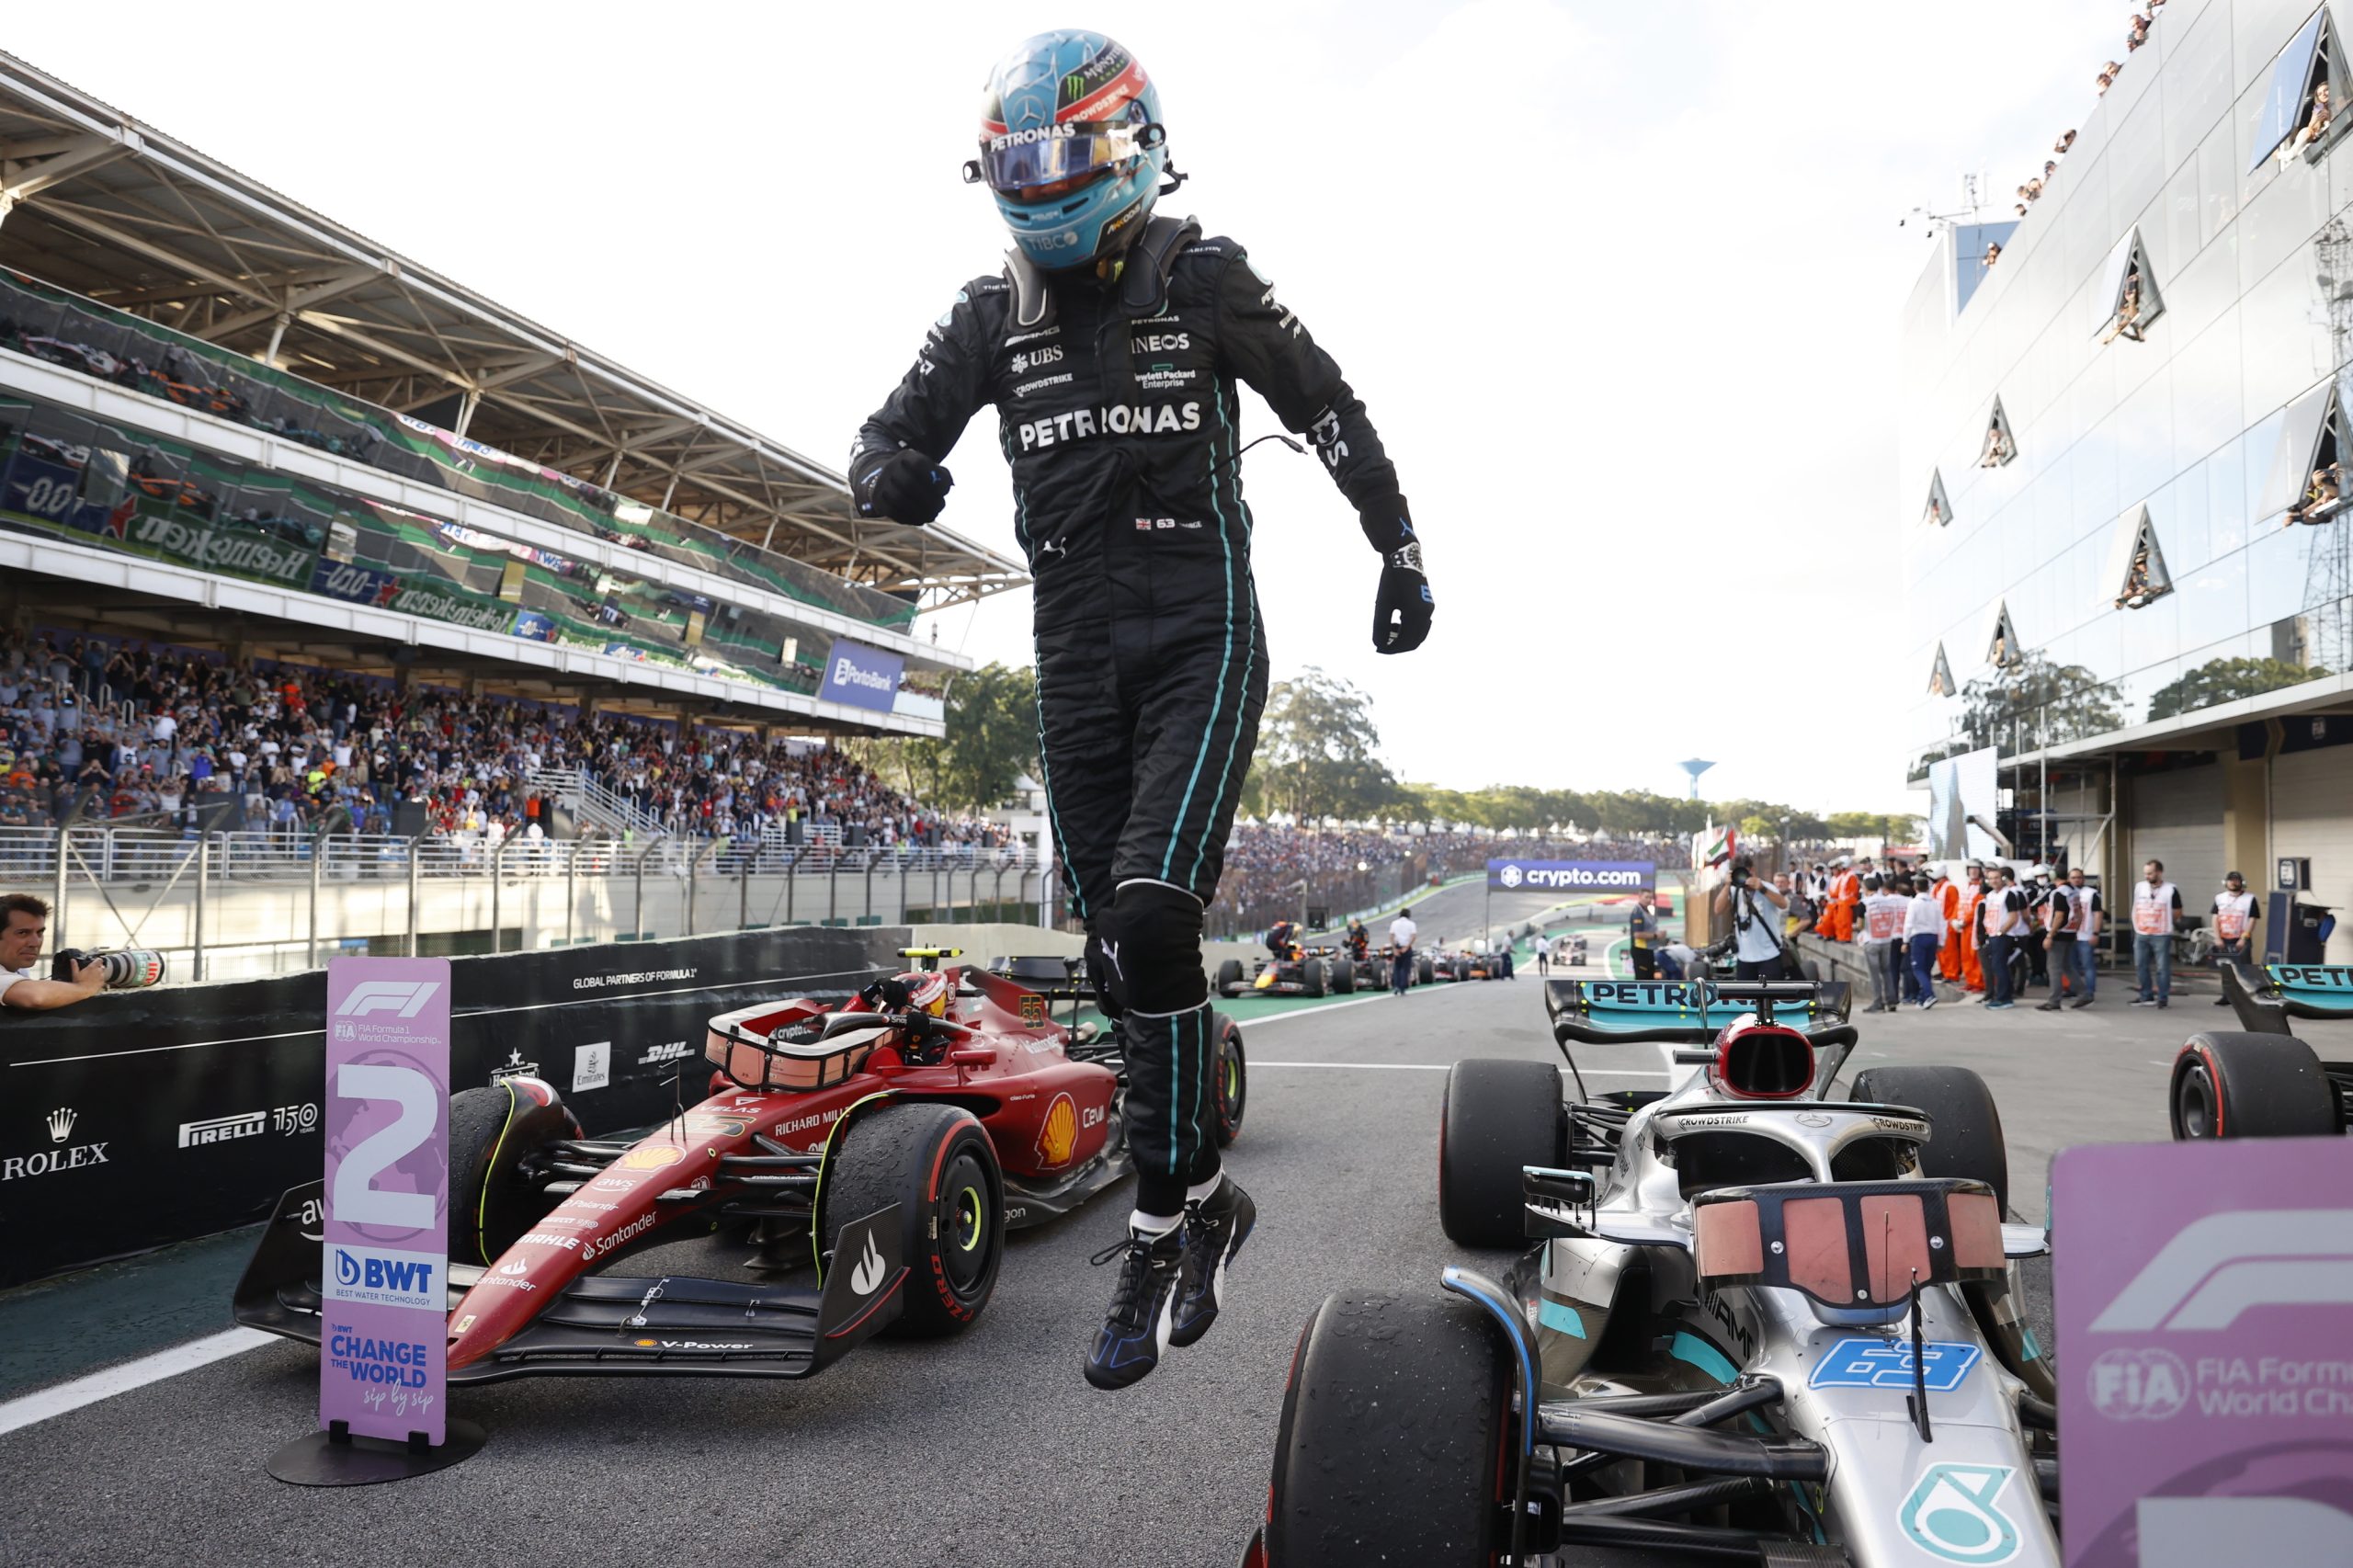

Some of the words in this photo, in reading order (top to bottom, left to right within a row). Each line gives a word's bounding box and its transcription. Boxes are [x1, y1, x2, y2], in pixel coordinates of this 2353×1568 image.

[991, 123, 1075, 153] PETRONAS
[1131, 315, 1180, 324] PETRONAS
[1131, 333, 1190, 355] INEOS
[1030, 345, 1063, 367] UBS
[1017, 372, 1074, 393] CROWDSTRIKE
[1142, 378, 1185, 390] Enterprise
[1164, 369, 1196, 380] Packard
[1019, 402, 1200, 451] PETRONAS
[1156, 518, 1176, 529] 63
[848, 665, 892, 691] PortoBank
[1527, 868, 1641, 887] crypto.com
[574, 976, 605, 989] GLOBAL
[607, 973, 644, 986] PARTNERS
[645, 971, 655, 982] OF
[656, 969, 689, 982] FORMULA
[2279, 968, 2353, 987] PET
[335, 982, 441, 1017] F1
[358, 1024, 370, 1032] FIA
[373, 1025, 404, 1034] Formula
[358, 1034, 381, 1042] World
[381, 1035, 438, 1044] Championship
[647, 1041, 688, 1061] DHL
[577, 1072, 605, 1085] Emirates
[699, 1106, 761, 1114] VELAS
[177, 1110, 267, 1149] PIRELLI
[775, 1115, 819, 1136] RICHARD
[1680, 1115, 1749, 1127] CROWDSTRIKE
[334, 1063, 439, 1230] 2
[2, 1142, 109, 1180] ROLEX
[597, 1178, 636, 1187] aws
[572, 1199, 620, 1210] Palantir
[516, 1233, 581, 1250] MAHLE
[596, 1210, 657, 1256] Santander
[365, 1258, 432, 1293] BWT
[355, 1291, 379, 1301] WATER
[381, 1294, 430, 1306] TECHNOLOGY
[331, 1335, 426, 1367] CHANGE
[661, 1340, 754, 1349] V-Power
[331, 1359, 348, 1369] THE
[349, 1361, 426, 1389] WORLD
[2196, 1358, 2251, 1385] FIA
[2257, 1358, 2353, 1385] Form
[364, 1387, 385, 1412] sip
[391, 1379, 407, 1416] by
[411, 1390, 434, 1415] sip
[2196, 1389, 2299, 1418] World
